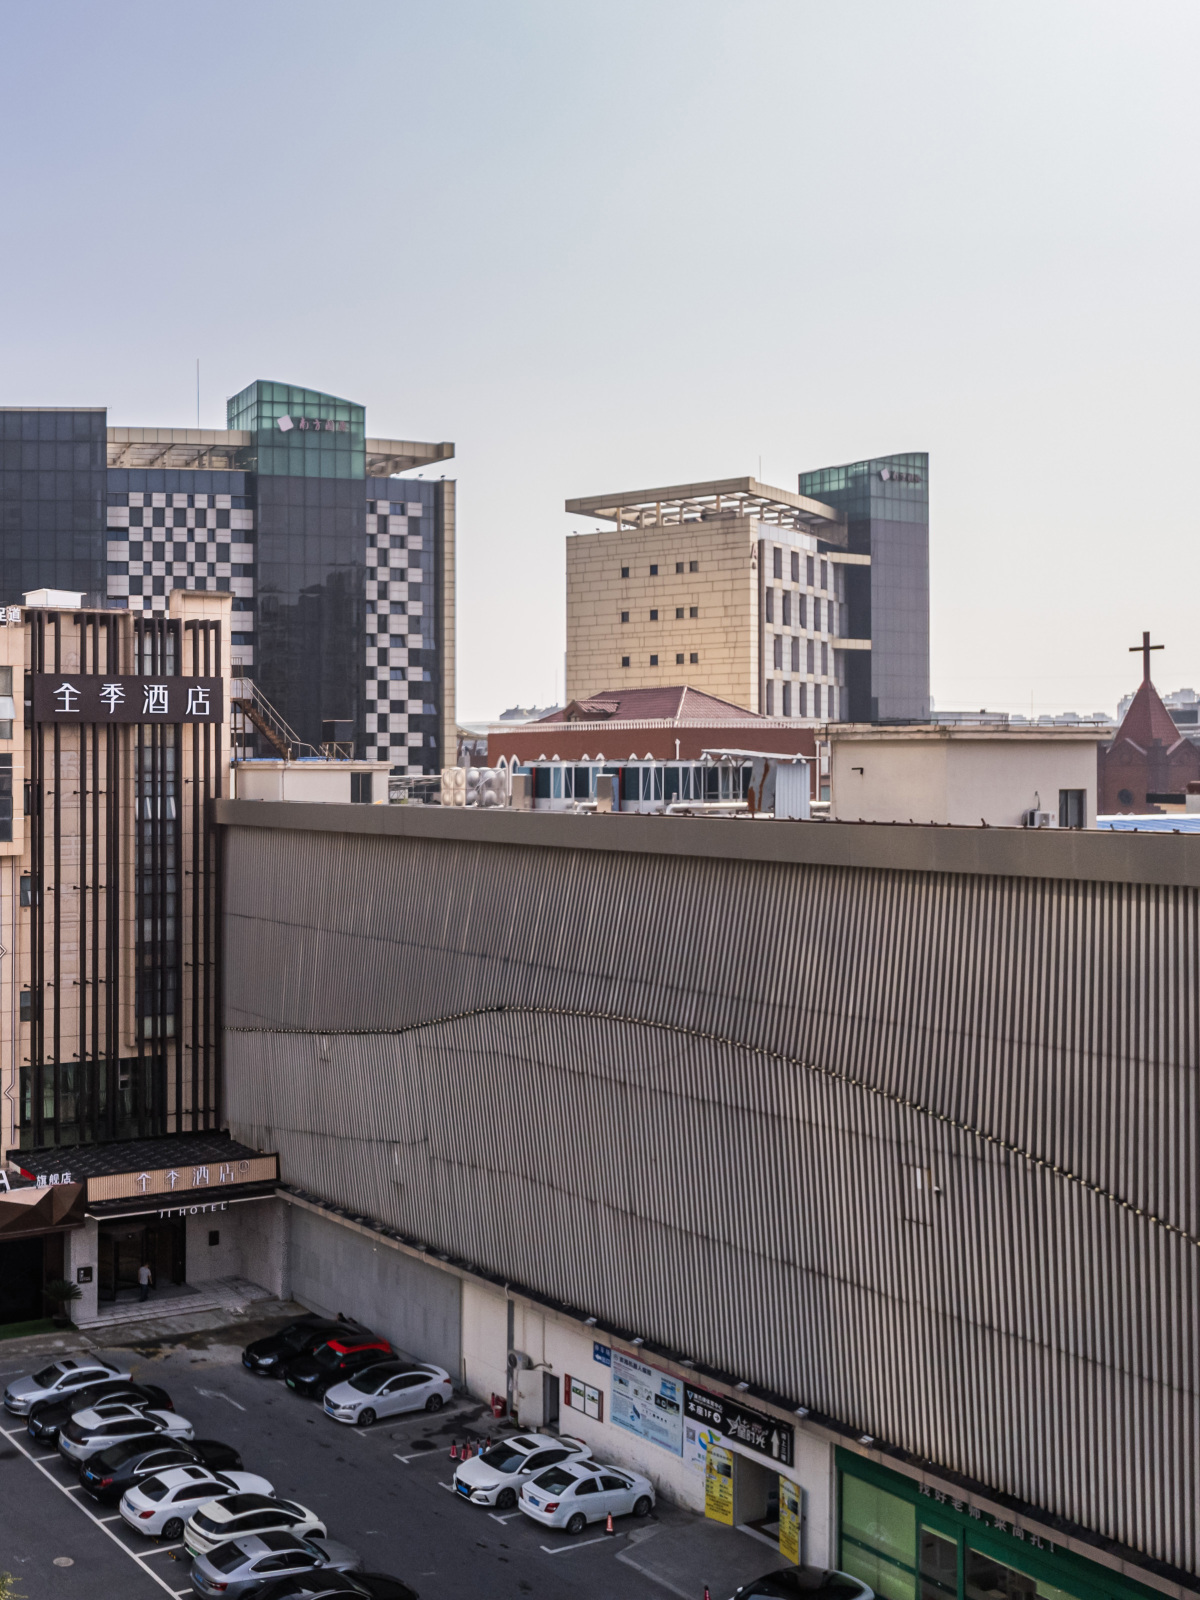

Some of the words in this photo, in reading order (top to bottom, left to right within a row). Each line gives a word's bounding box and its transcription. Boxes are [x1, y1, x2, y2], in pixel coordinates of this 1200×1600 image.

[52, 682, 211, 716] 全季酒店
[36, 1171, 73, 1188] 旗舰店
[136, 1162, 234, 1193] 全季酒店
[179, 1202, 227, 1217] HOTEL
